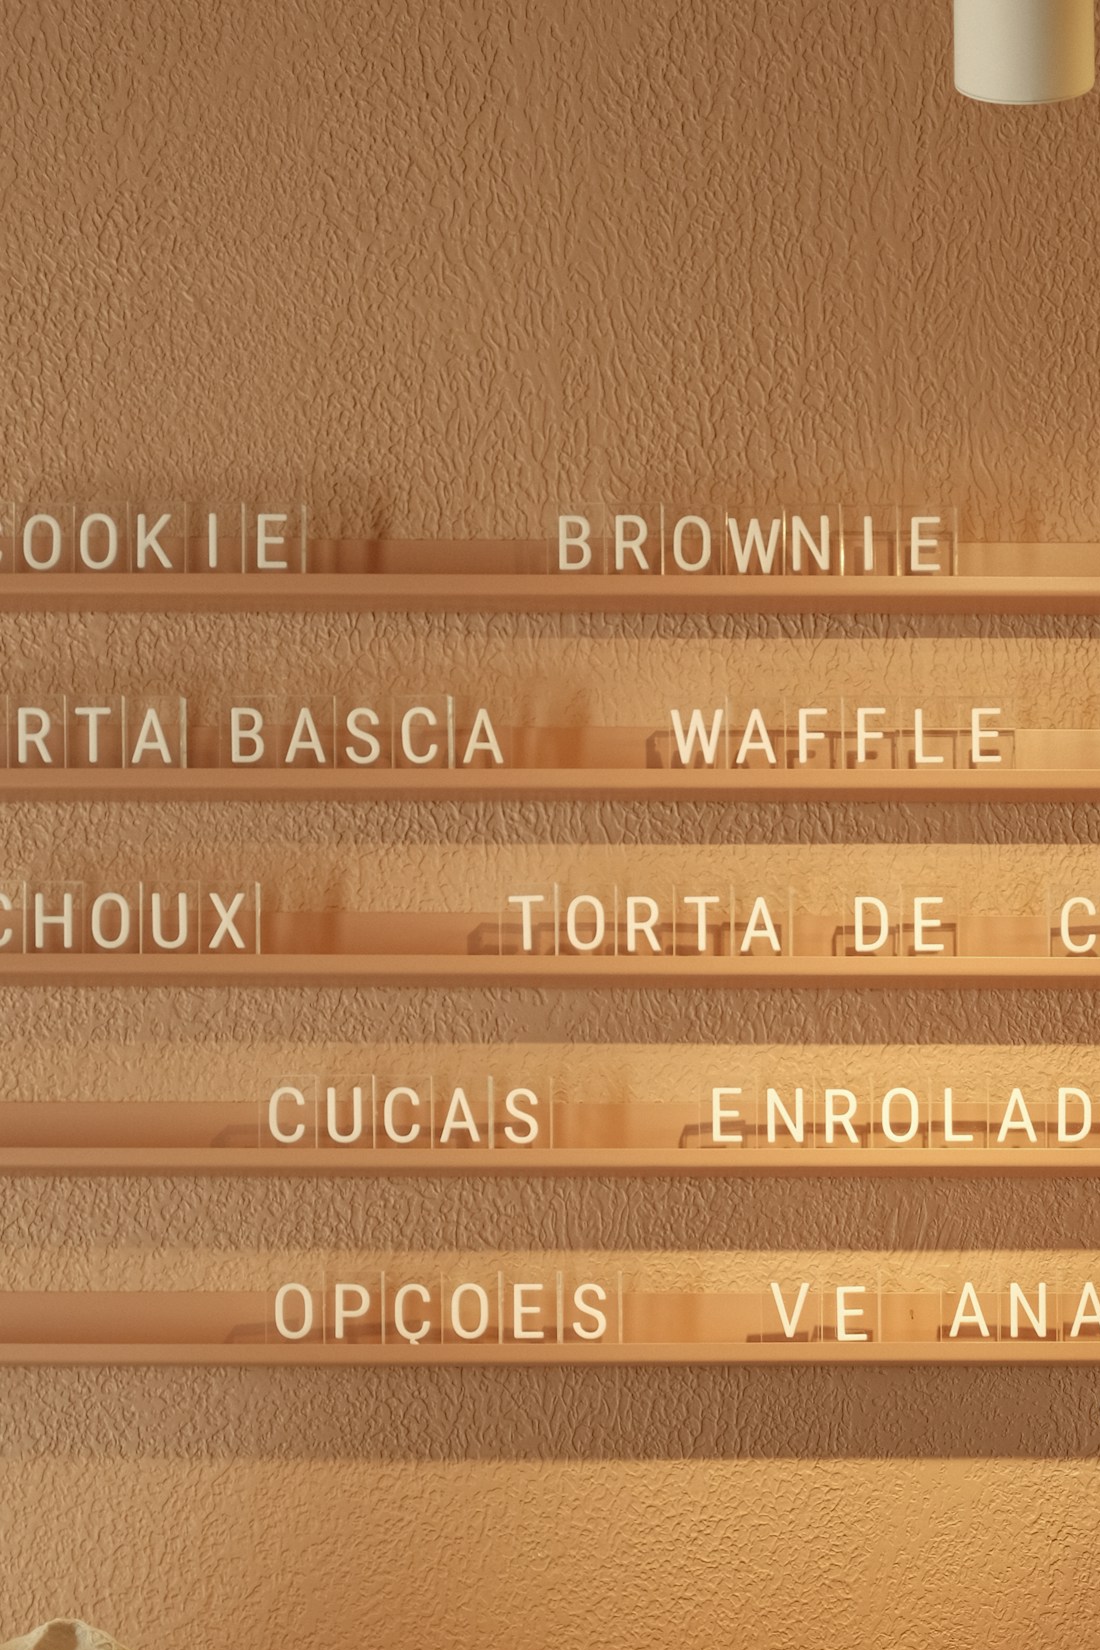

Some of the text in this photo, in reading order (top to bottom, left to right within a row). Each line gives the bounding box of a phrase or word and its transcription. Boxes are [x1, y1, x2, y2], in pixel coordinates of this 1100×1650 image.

[0, 513, 288, 570] OOKIE
[558, 515, 941, 574] BROWNIE
[230, 706, 504, 764] BASCA
[670, 707, 1002, 764] WAFFLE
[508, 894, 781, 952] TORTA
[854, 896, 945, 952] DE
[268, 1086, 539, 1144] CUCAS
[275, 1282, 607, 1345] OPÇOES
[770, 1282, 868, 1341] VE
